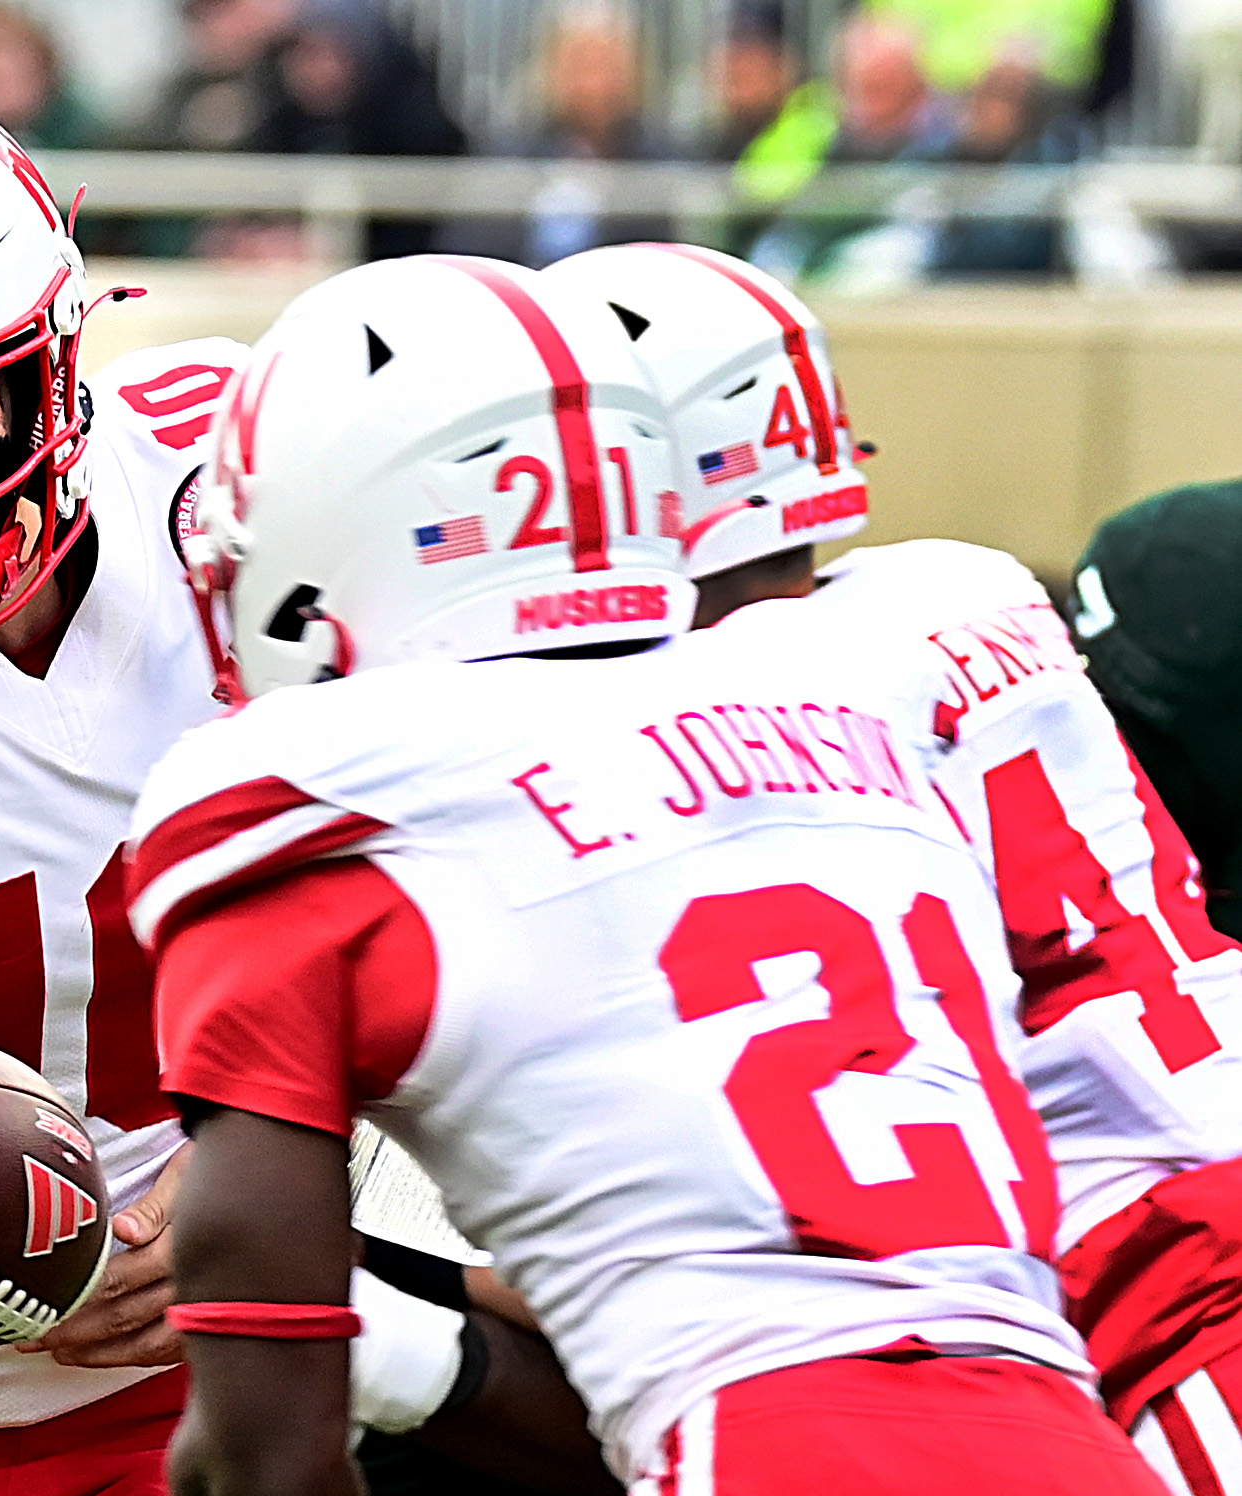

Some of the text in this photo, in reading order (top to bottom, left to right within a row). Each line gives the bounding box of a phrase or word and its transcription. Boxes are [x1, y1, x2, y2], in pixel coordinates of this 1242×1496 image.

[177, 474, 204, 541] EBRASK
[495, 446, 638, 549] 21
[511, 762, 637, 859] E.
[659, 883, 1062, 1272] 21
